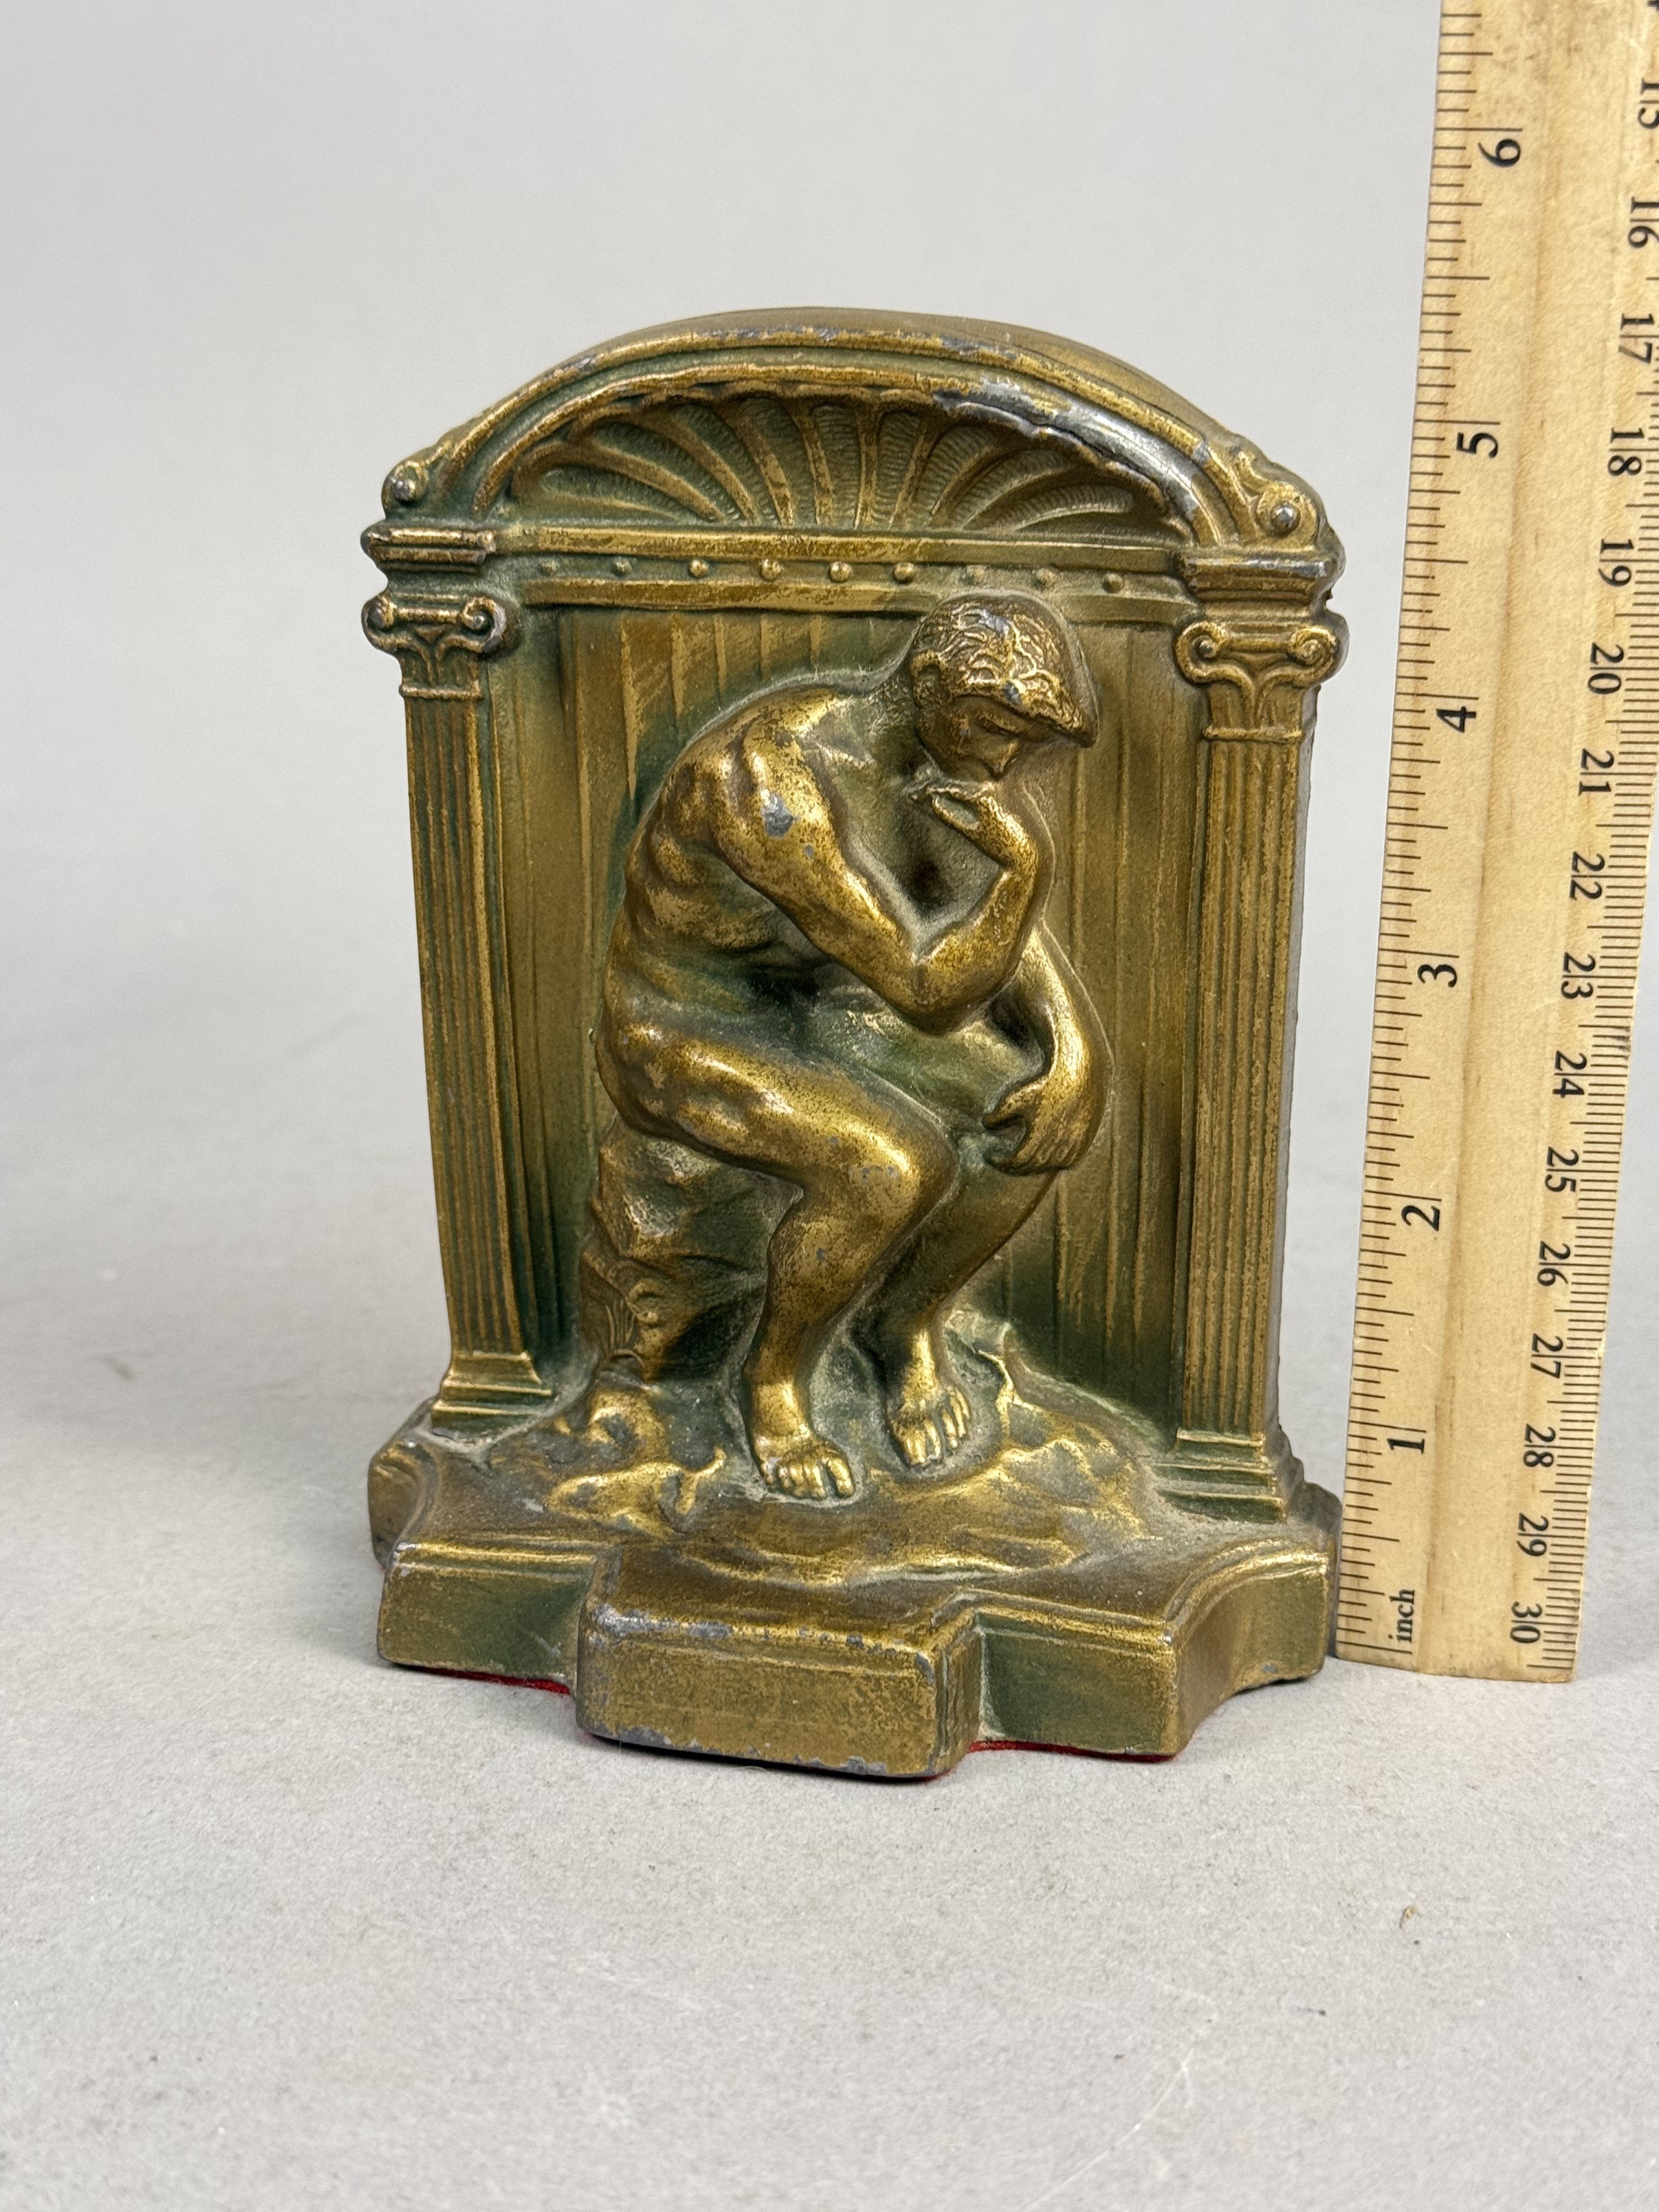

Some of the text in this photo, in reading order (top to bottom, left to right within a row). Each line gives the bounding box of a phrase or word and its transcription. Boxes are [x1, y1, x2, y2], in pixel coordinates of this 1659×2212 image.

[1627, 196, 1659, 249] 16
[1618, 313, 1655, 364] 17
[1455, 431, 1499, 459] 5
[1607, 427, 1645, 477] 18
[1598, 538, 1635, 588] 19
[1587, 642, 1624, 696] 20
[1435, 706, 1477, 733] 4
[1578, 747, 1615, 797] 21
[1568, 851, 1606, 901] 22
[1417, 963, 1458, 989] 3
[1560, 951, 1596, 1000] 23
[1552, 1049, 1588, 1099] 24
[1544, 1146, 1579, 1193] 25
[1401, 1205, 1441, 1232] 2
[1536, 1240, 1571, 1287] 26
[1530, 1333, 1564, 1379] 27
[1386, 1437, 1425, 1455] 1
[1522, 1423, 1556, 1468] 28
[1515, 1512, 1549, 1558] 29
[1388, 1589, 1415, 1644] inch
[1509, 1601, 1543, 1644] 30
